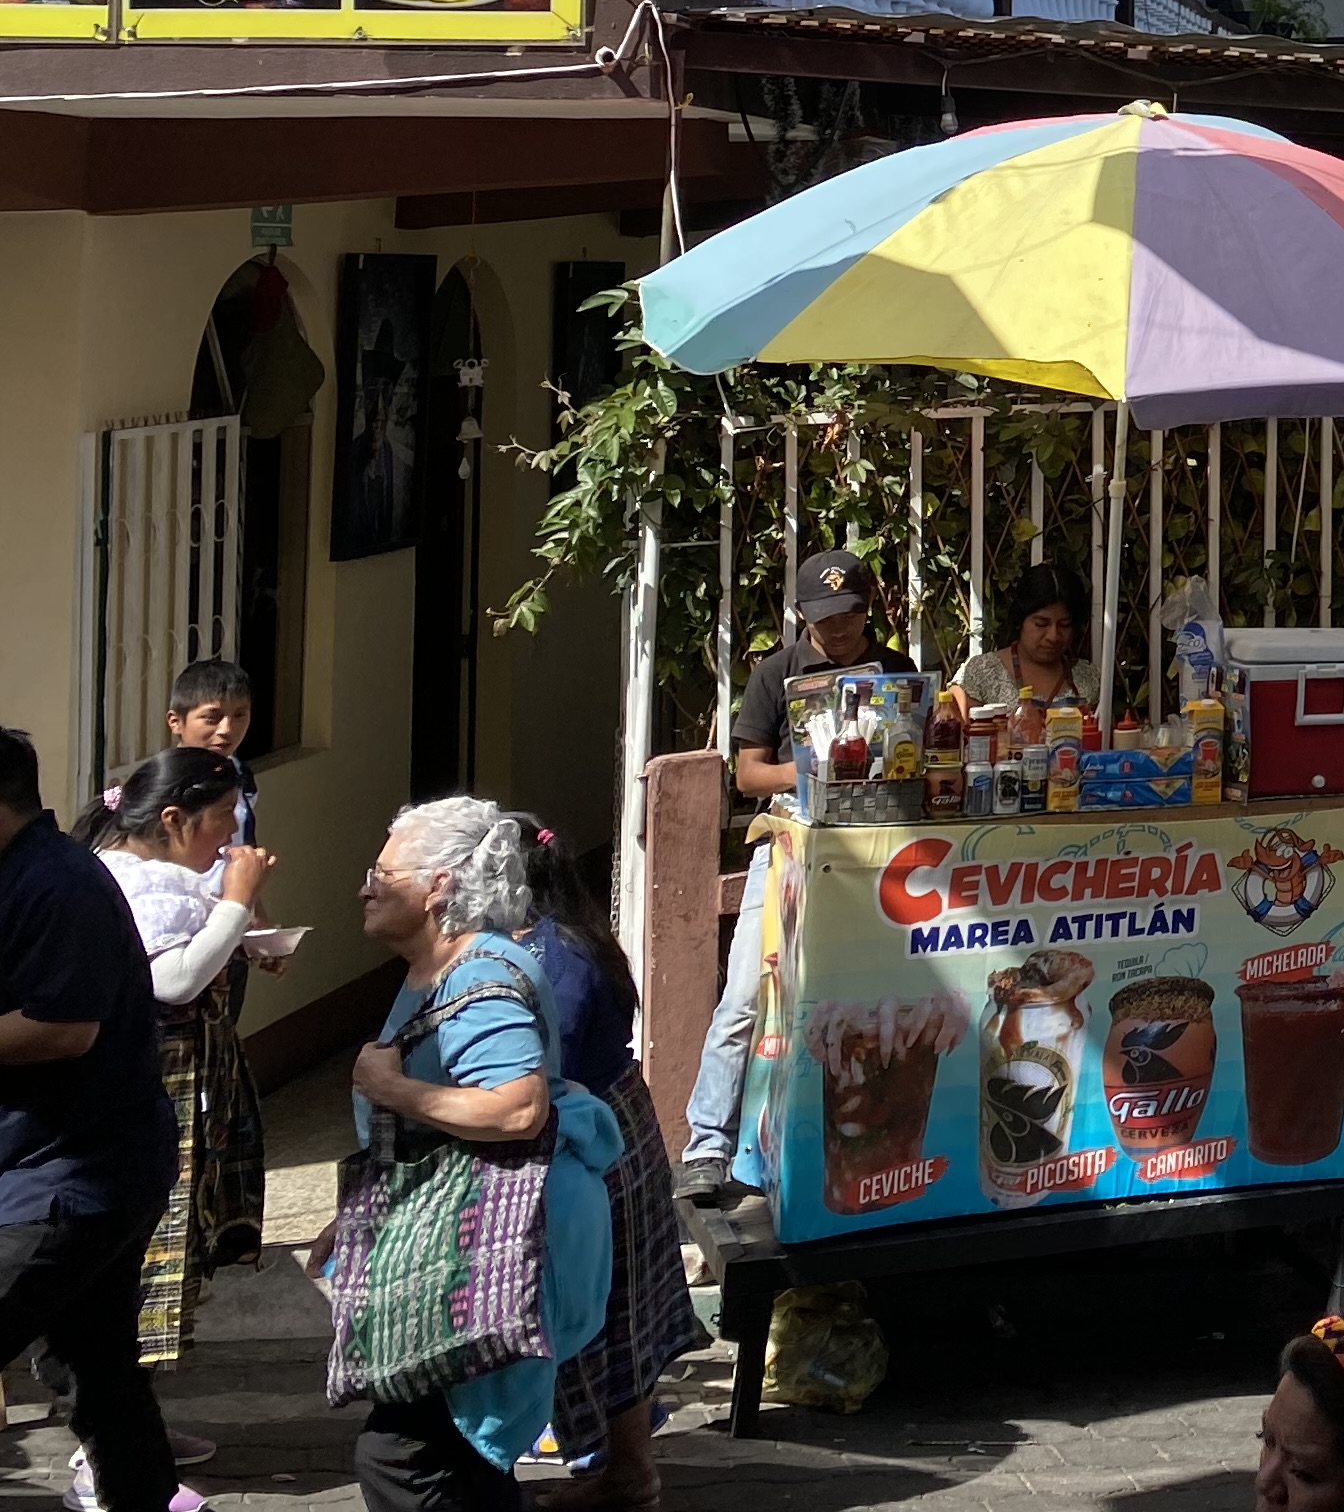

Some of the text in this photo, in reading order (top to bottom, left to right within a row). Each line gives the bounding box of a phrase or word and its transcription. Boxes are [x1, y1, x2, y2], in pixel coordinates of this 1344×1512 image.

[879, 837, 1223, 926] CEVICHERÍA
[910, 902, 1196, 955] MAREA ATITLÁN
[1246, 943, 1327, 980] MICHELADA
[1109, 1086, 1206, 1124] Gallo
[1119, 1122, 1190, 1140] CERVEZA
[1025, 1148, 1107, 1194] PICOSITA
[1146, 1139, 1228, 1179] CANTARITO
[858, 1159, 935, 1206] CEVICHE
